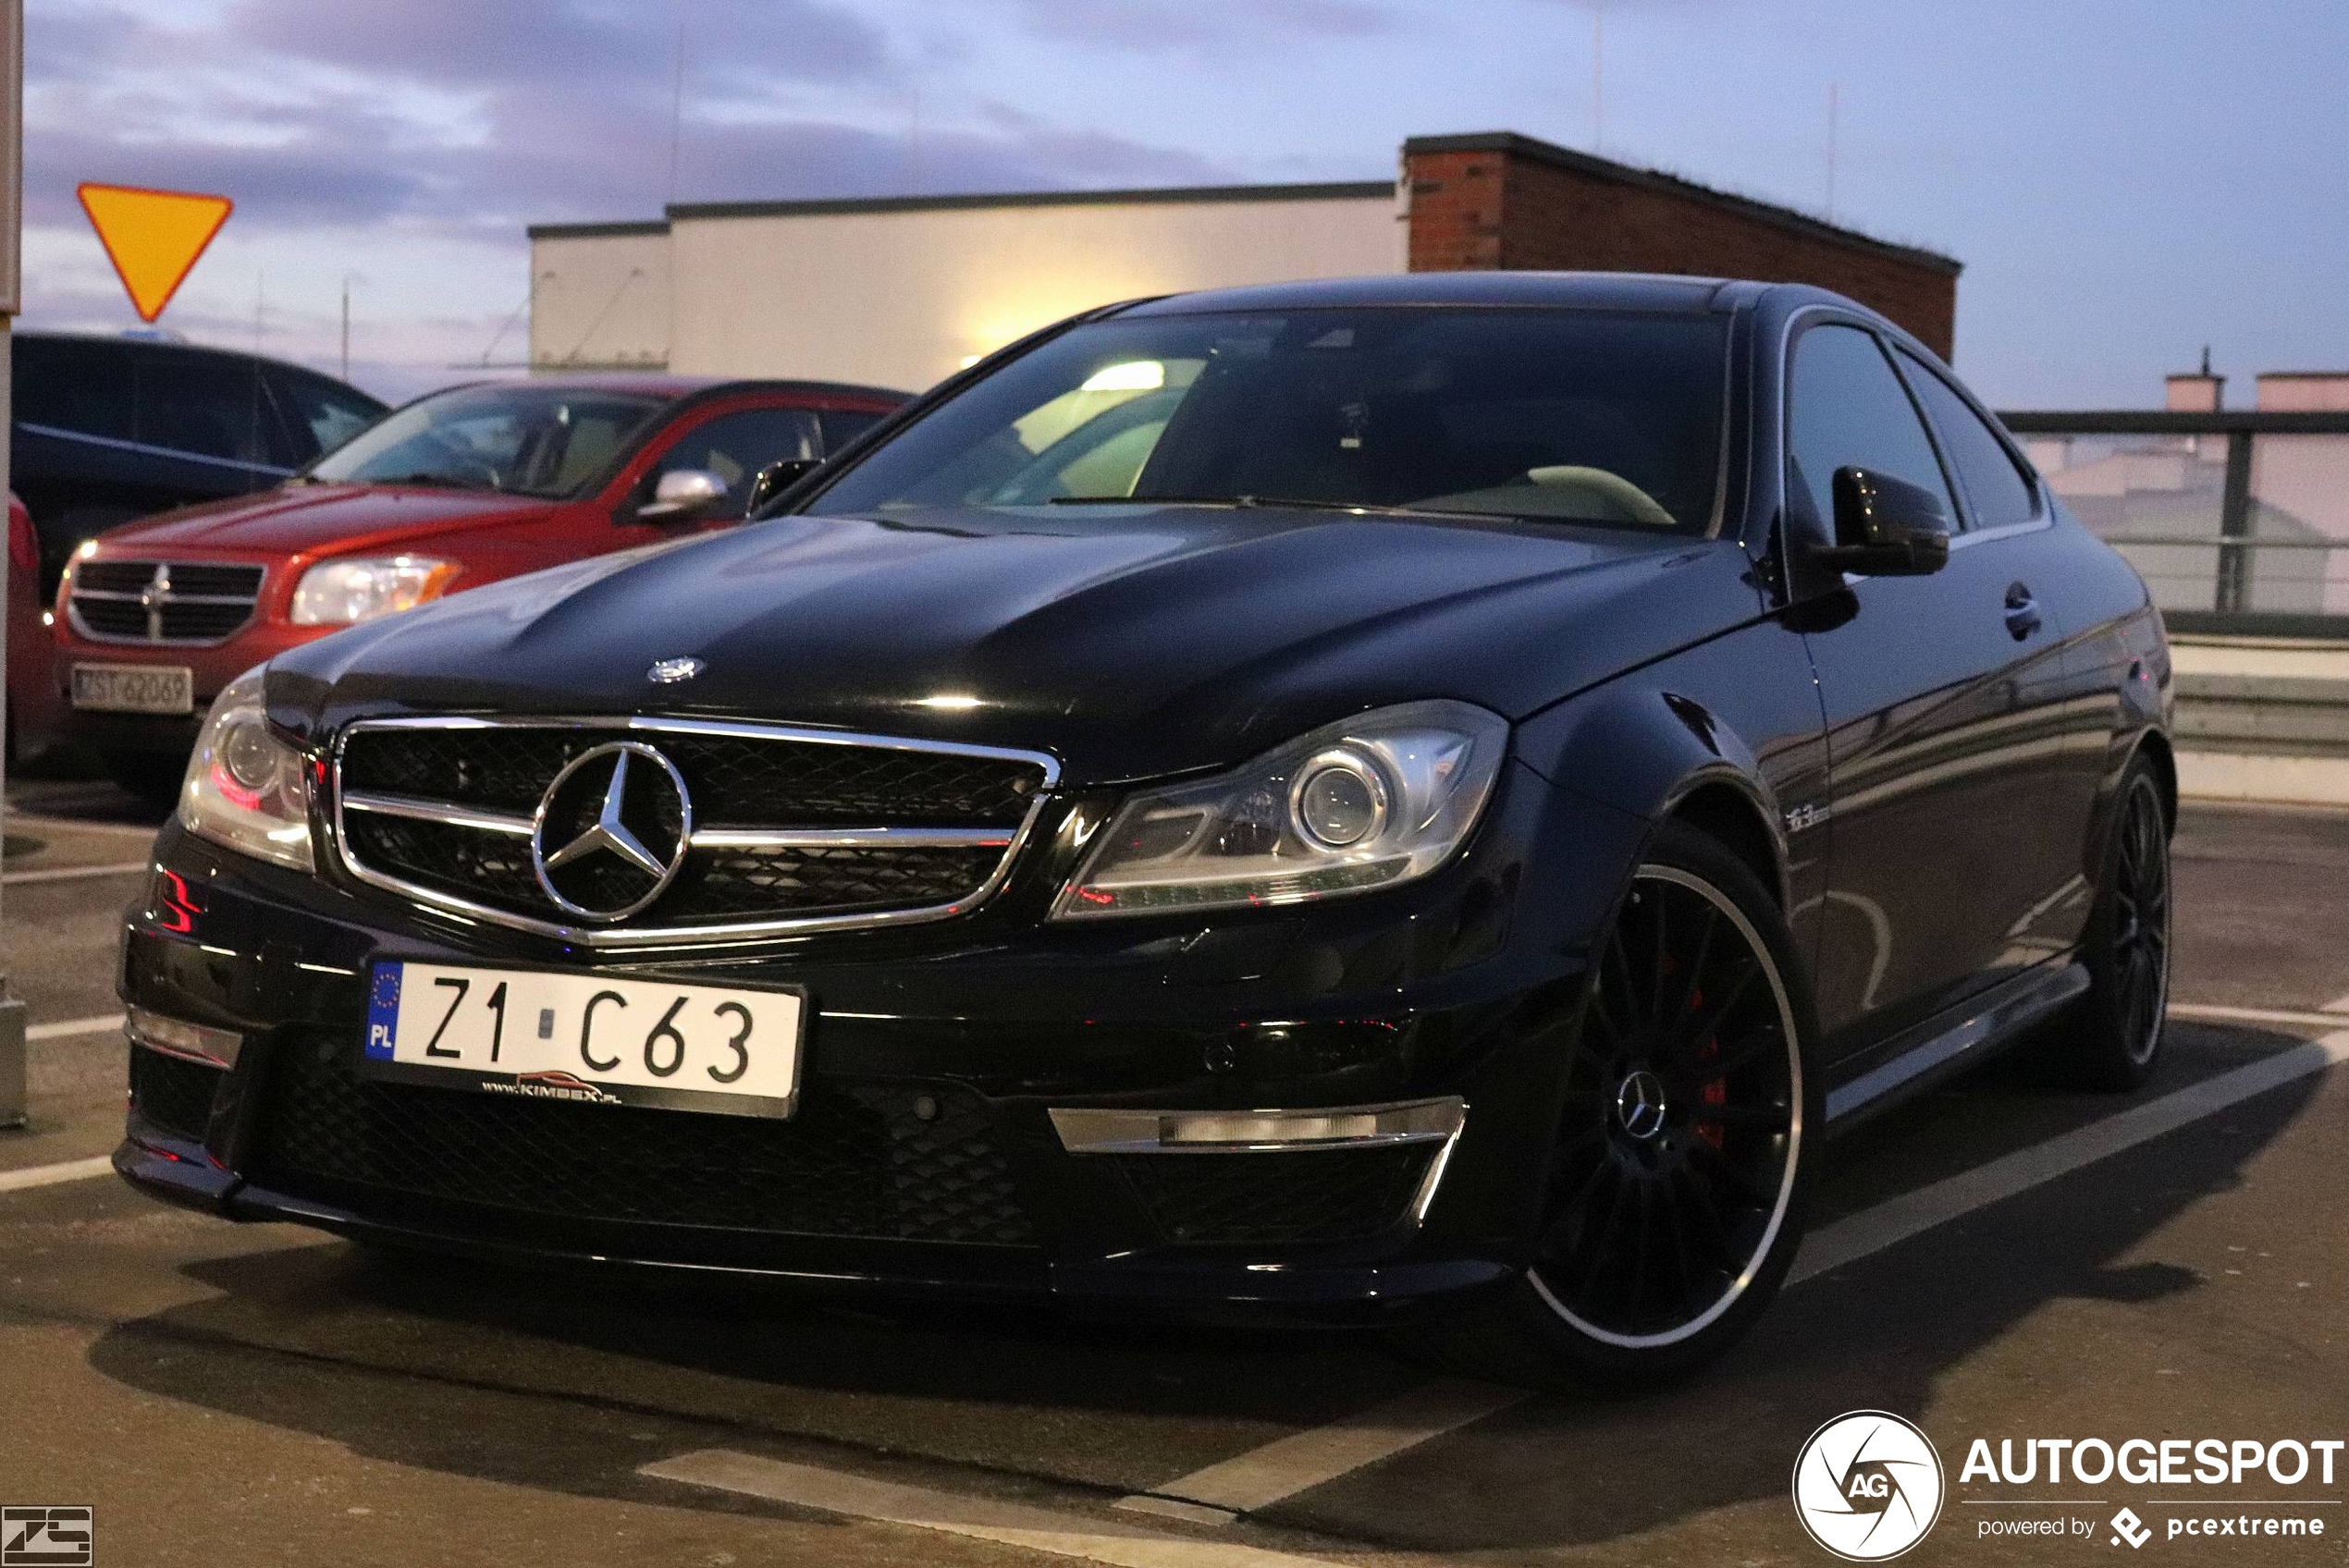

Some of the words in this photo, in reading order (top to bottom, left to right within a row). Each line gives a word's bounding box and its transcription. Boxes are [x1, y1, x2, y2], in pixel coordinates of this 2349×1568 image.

[371, 1024, 392, 1048] PL
[426, 977, 508, 1062] Z1
[581, 990, 754, 1084] C63
